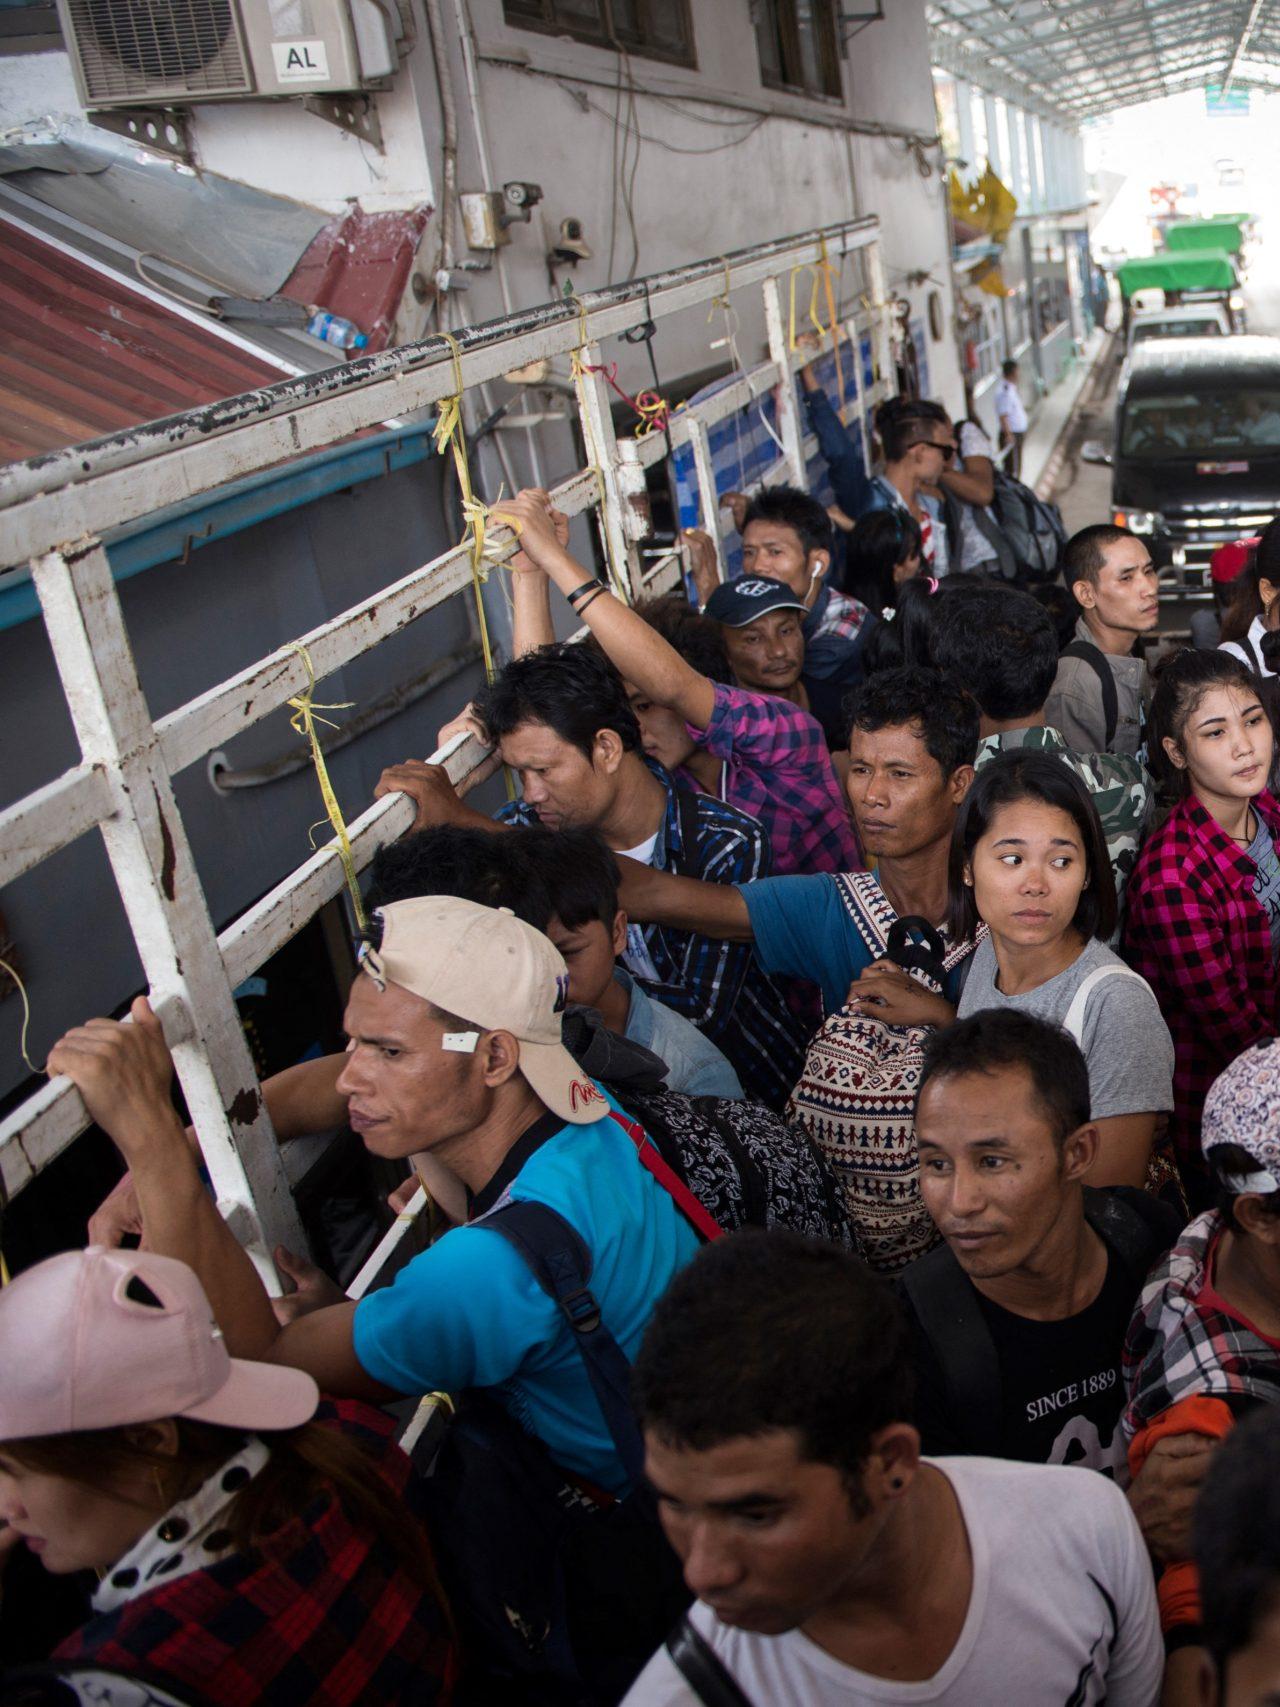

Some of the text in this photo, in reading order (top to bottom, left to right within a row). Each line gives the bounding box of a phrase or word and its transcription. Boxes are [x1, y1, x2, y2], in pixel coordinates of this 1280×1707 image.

[287, 47, 317, 69] AL
[1026, 1368, 1117, 1422] SINCE 1889
